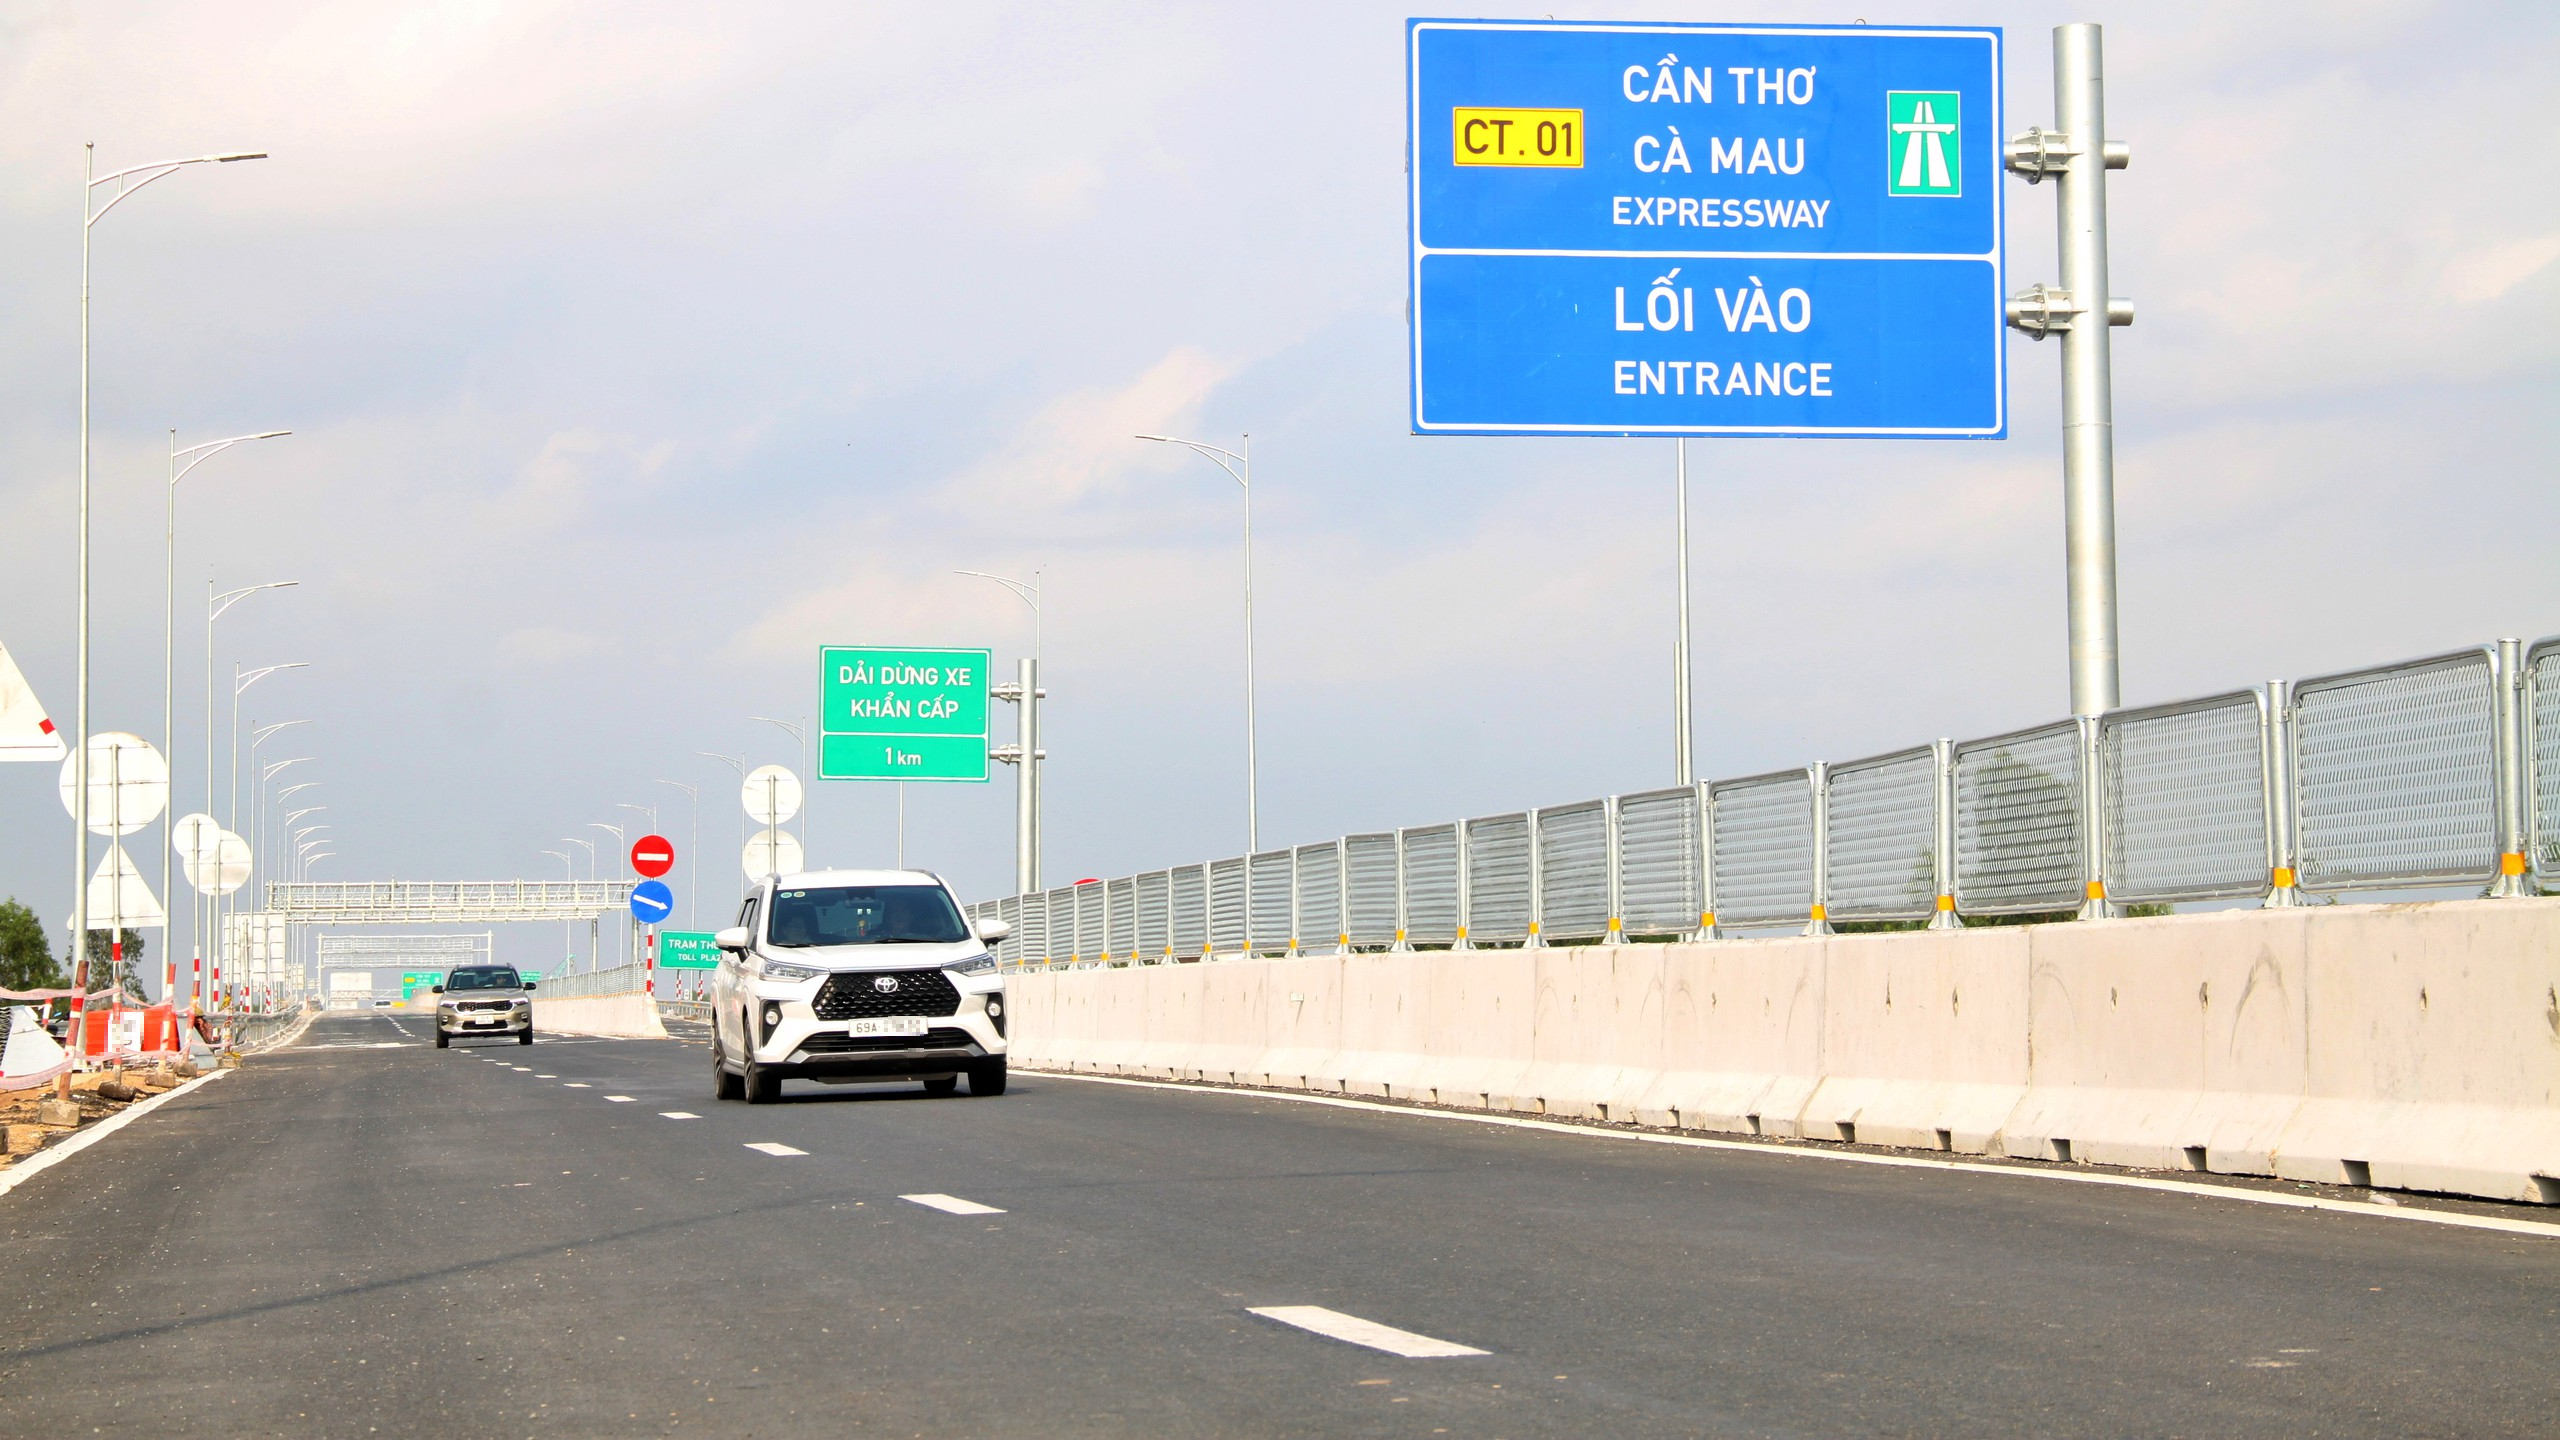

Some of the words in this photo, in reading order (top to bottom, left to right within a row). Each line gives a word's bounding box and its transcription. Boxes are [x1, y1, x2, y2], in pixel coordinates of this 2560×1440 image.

[1622, 53, 1713, 104] CẦN
[1727, 66, 1817, 105] THƠ
[1633, 130, 1693, 174] CÀ
[1710, 137, 1805, 175] MAU
[1612, 197, 1831, 229] EXPRESSWAY
[1615, 268, 1694, 332] LỐI
[1714, 276, 1811, 333] VÀO
[1614, 361, 1833, 397] ENTRANCE
[839, 660, 874, 685] DẢI
[881, 661, 939, 686] DỪNG
[945, 667, 972, 686] XE
[851, 691, 911, 718] KHẨN
[917, 693, 959, 719] CẤP
[885, 747, 892, 765] 1
[897, 750, 922, 766] km
[668, 939, 698, 951] TRẠM
[677, 953, 697, 961] TOLL
